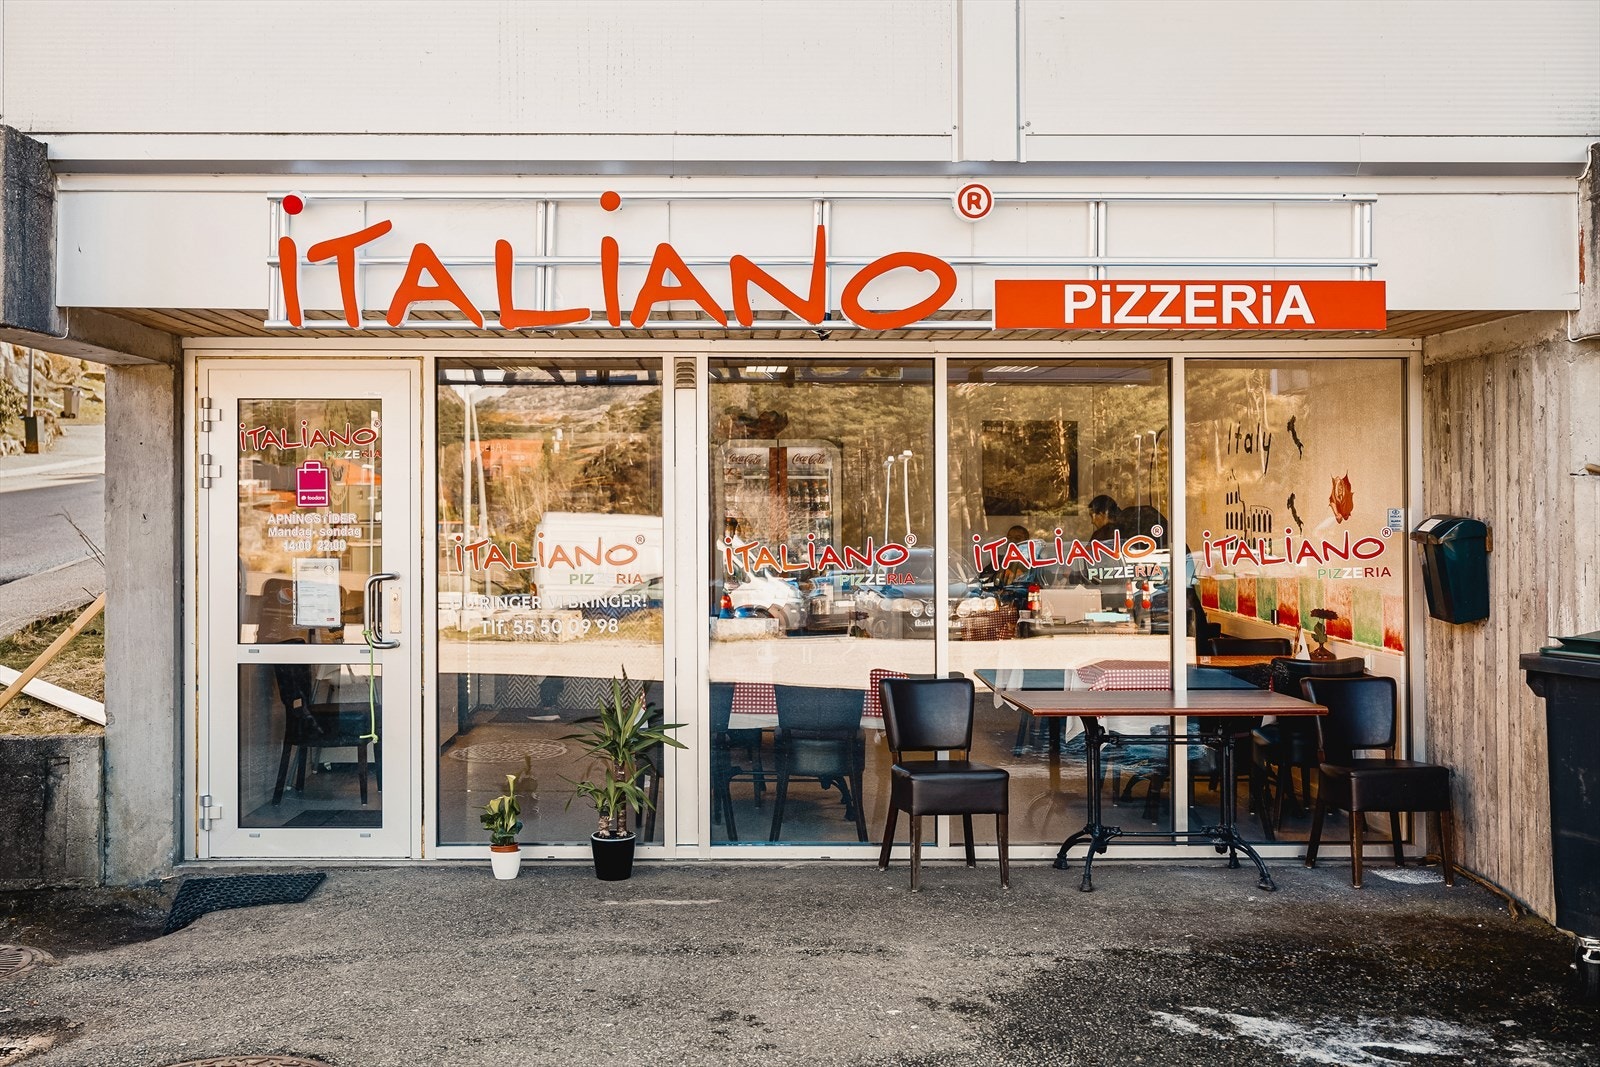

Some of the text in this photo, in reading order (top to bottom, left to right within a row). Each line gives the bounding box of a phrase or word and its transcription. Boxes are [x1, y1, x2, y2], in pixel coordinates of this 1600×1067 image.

[1087, 564, 1163, 580] PIZZERIA
[1317, 566, 1392, 579] PIZZERIA
[569, 573, 643, 585] PIZRIA
[839, 573, 915, 586] PIZZERIA
[513, 619, 535, 635] 55
[540, 619, 563, 634] 50
[596, 618, 619, 634] 98
